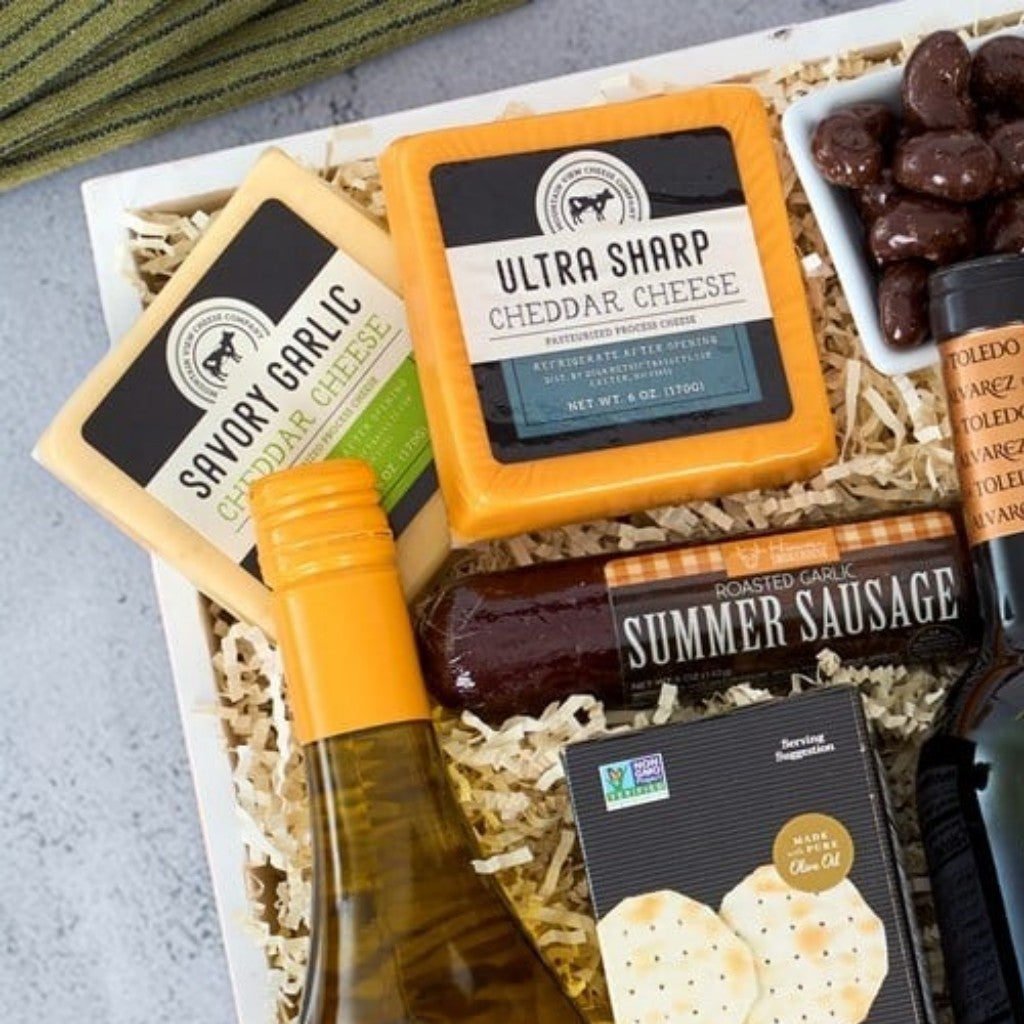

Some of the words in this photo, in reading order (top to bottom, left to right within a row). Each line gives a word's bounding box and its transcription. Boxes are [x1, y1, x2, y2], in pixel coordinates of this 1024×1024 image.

[496, 247, 598, 293] ULTRA
[607, 230, 710, 277] SHARP
[489, 290, 624, 330] CHEDDAR
[633, 272, 740, 309] CHEESE
[310, 313, 392, 407] CHEESE
[947, 337, 1021, 370] TOLEDO
[178, 384, 280, 499] SAVORY
[266, 284, 362, 391] GARLIC
[567, 400, 594, 412] NET
[627, 393, 637, 403] 6
[639, 389, 658, 400] OZ
[714, 573, 794, 600] ROASTED
[799, 563, 856, 586] GARLIC
[622, 594, 788, 671] SUMMER
[796, 566, 960, 643] SAUSAGE
[775, 743, 835, 763] Suggestion
[780, 733, 825, 751] Serving
